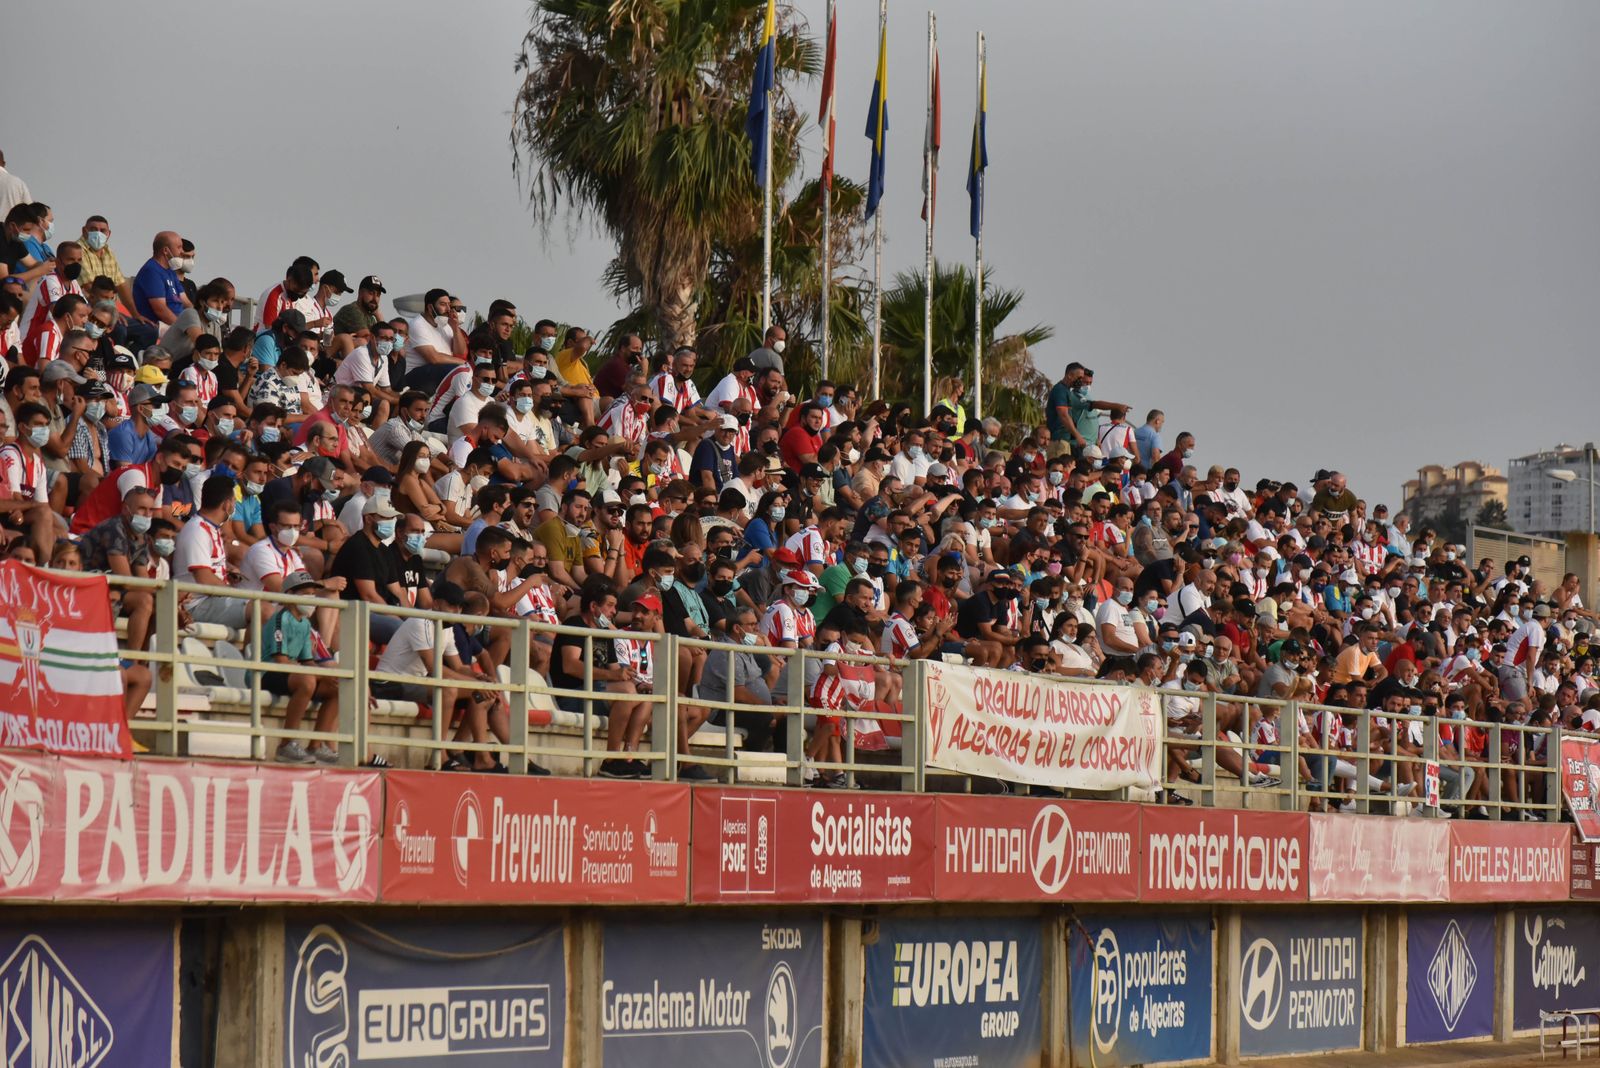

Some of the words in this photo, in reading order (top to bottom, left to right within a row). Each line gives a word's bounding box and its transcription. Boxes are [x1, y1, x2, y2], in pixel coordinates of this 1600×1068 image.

[973, 676, 1040, 721] ORGULLO
[1034, 730, 1057, 769] EN
[1059, 733, 1078, 769] EL
[61, 769, 317, 888] PADILLA
[490, 796, 577, 884] Preventor
[582, 822, 618, 852] Servicio
[621, 827, 634, 853] de
[723, 819, 746, 837] Algeciras
[810, 801, 912, 856] Socialistas
[945, 826, 1027, 874] HYUNDAI
[581, 855, 633, 884] Prevención
[722, 842, 746, 872] PSOE
[1076, 831, 1131, 875] PERMOTOR
[1149, 815, 1300, 892] master.house
[1454, 845, 1510, 883] HOTELES
[1511, 838, 1565, 883] ALBORÁN
[810, 864, 822, 888] de
[823, 864, 862, 893] Algeciras
[761, 924, 802, 950] ŠKODA
[1289, 937, 1356, 982] HYUNDAI
[892, 940, 1019, 1007] EUROPEA
[1124, 940, 1186, 999] populares
[365, 998, 546, 1043] EUROGRUAS
[601, 979, 695, 1031] Grazalema
[698, 978, 751, 1028] Motor
[981, 1010, 1019, 1038] GROUP
[1129, 1006, 1139, 1033] de
[1142, 994, 1185, 1038] Algeciras
[1288, 988, 1355, 1030] PERMOTOR
